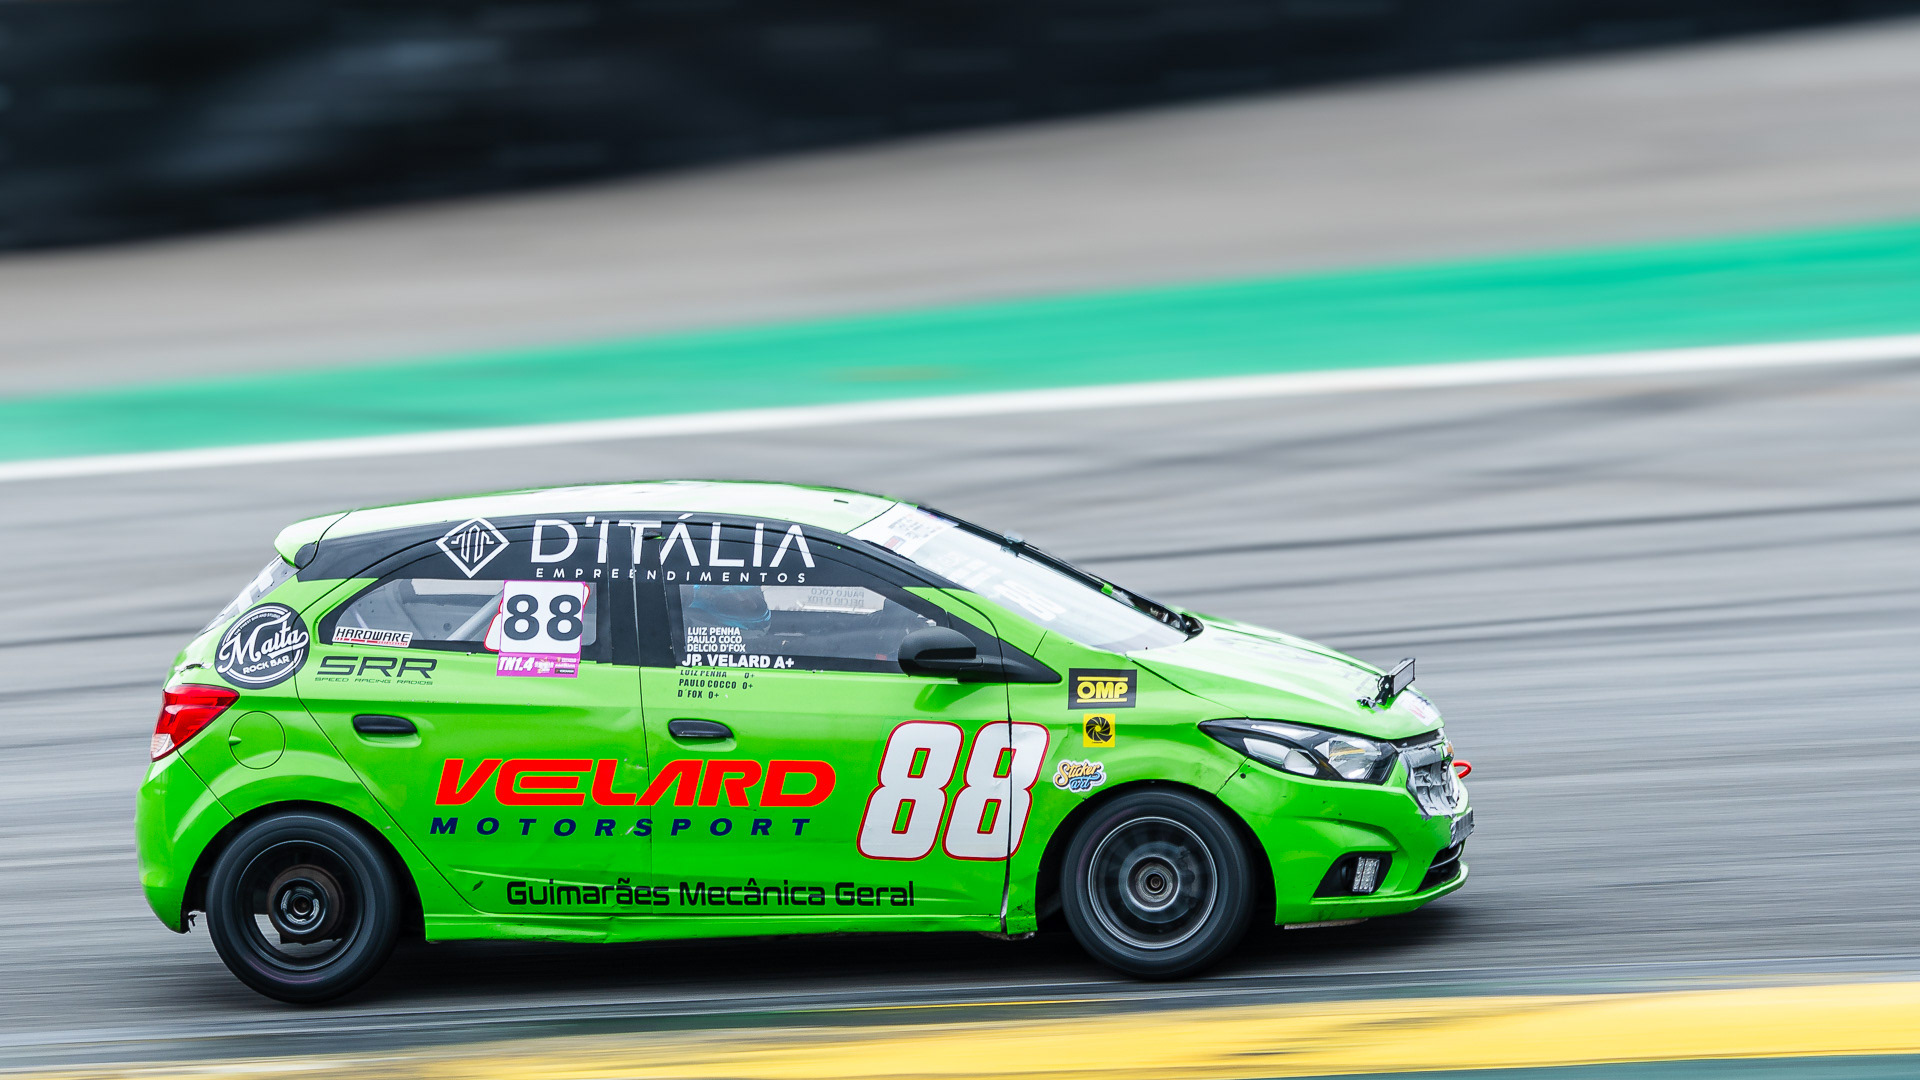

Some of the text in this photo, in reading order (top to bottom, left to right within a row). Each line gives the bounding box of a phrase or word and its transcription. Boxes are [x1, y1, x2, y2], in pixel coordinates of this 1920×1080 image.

[531, 513, 815, 567] D'ITÁLIA
[536, 568, 805, 583] EMPREENDIMENTOS
[503, 594, 584, 641] 88
[335, 628, 412, 643] HARDWARE
[687, 627, 741, 636] LUIZ PENHA
[687, 635, 743, 644] PAULO COCO
[687, 643, 746, 653] DELCIO D'FOX
[243, 655, 291, 675] ROCK BAR
[317, 656, 437, 679] SRR
[498, 656, 535, 671] TN1.4
[707, 653, 771, 668] VELARD
[773, 655, 795, 669] A+
[678, 678, 705, 688] PAULO
[707, 680, 737, 689] COCCO
[1077, 681, 1128, 699] OMP
[435, 758, 836, 807] VELARD
[1055, 762, 1102, 788] Sticker
[1068, 772, 1101, 790] art
[856, 720, 1050, 861] 88
[430, 817, 811, 837] MOTORSPORT
[506, 877, 915, 907] Guimarães Mecânica Geral
